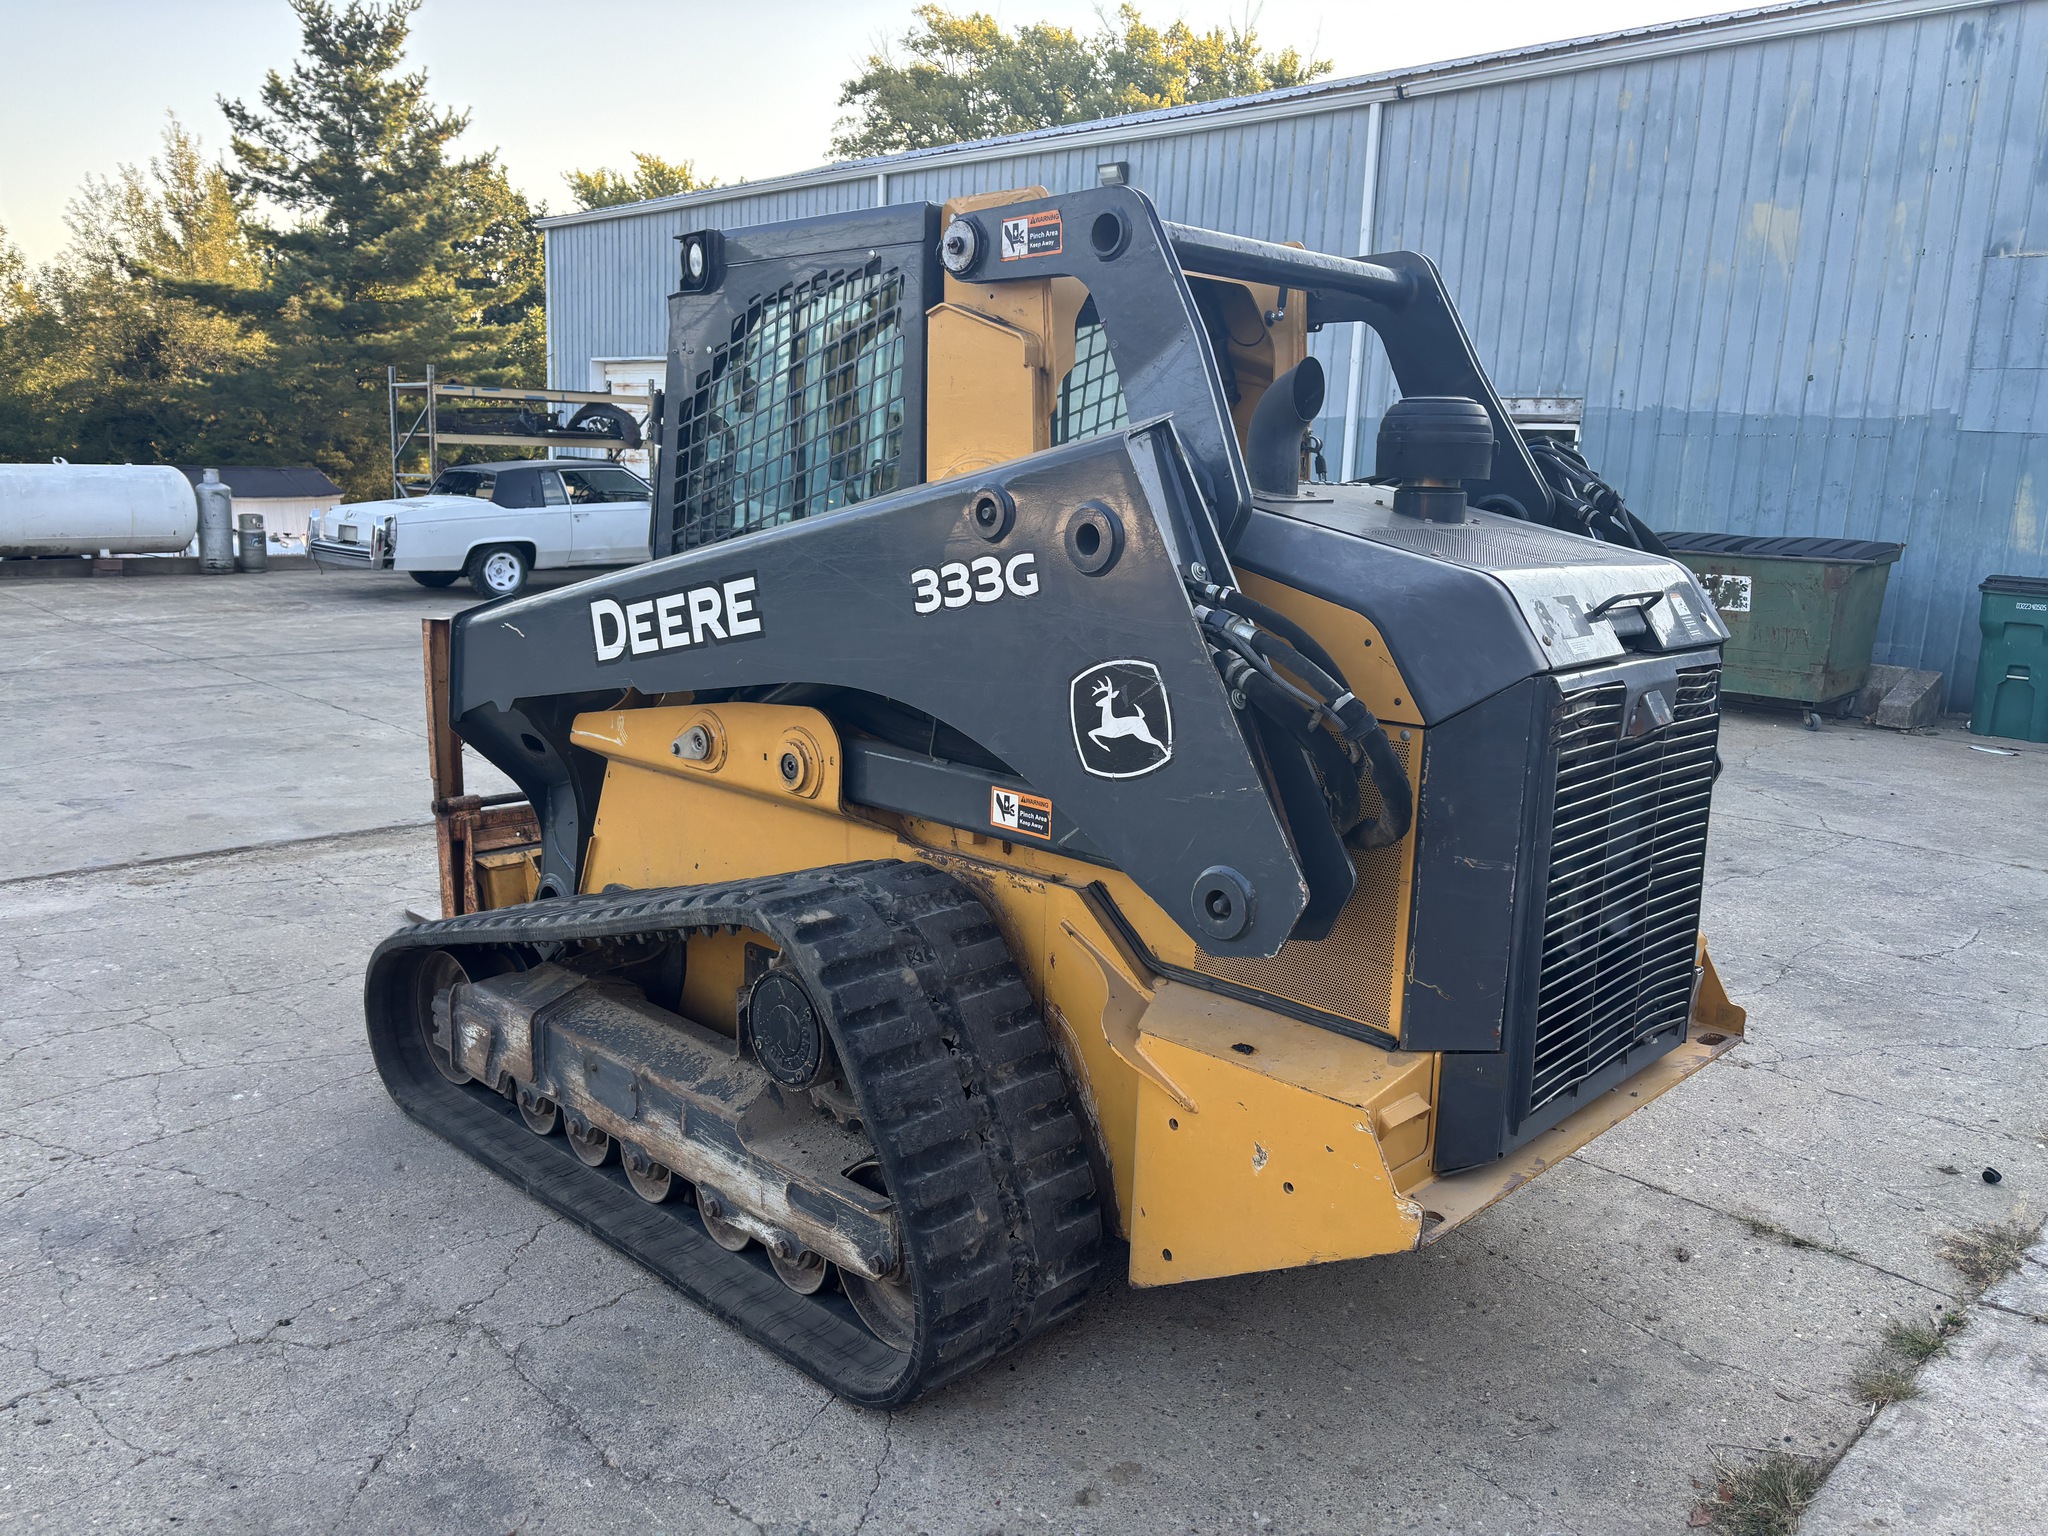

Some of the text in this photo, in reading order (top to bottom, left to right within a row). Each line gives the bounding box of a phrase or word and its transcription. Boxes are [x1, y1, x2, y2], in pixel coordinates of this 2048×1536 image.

[1035, 213, 1060, 224] WARNING
[1030, 230, 1059, 240] Pinch Area
[1030, 241, 1041, 249] Keep
[911, 553, 1039, 613] 333G
[591, 577, 761, 661] DEERE
[1025, 798, 1049, 809] WARNING
[1020, 810, 1048, 822] Pinch Area
[1020, 819, 1043, 830] Keep Away
